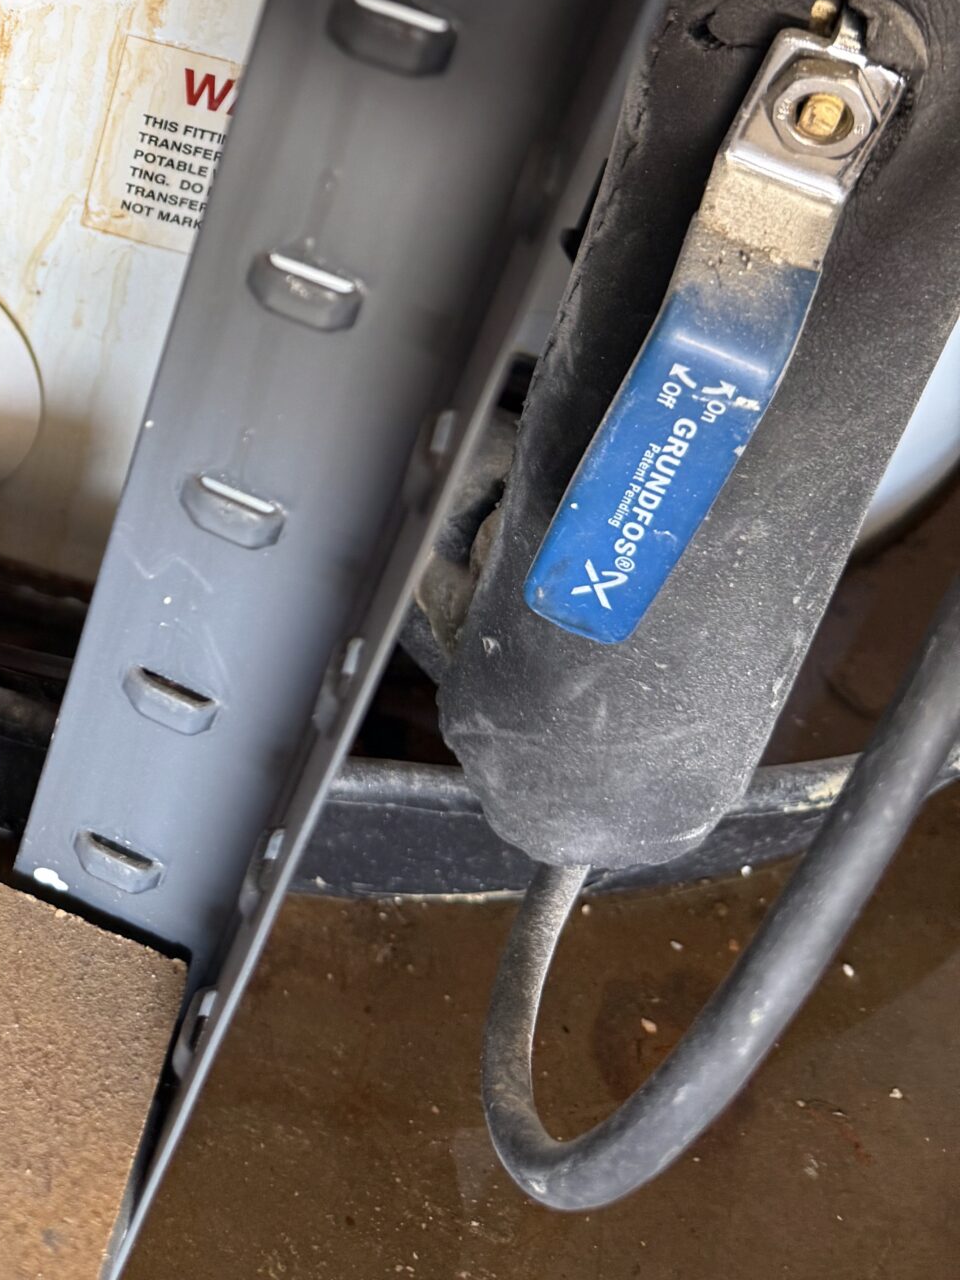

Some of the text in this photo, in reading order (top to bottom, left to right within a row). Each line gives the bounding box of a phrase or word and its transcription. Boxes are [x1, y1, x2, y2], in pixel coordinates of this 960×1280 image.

[184, 67, 239, 116] W
[143, 113, 179, 133] THIS
[133, 149, 209, 178] POTABLE
[129, 165, 170, 187] TING.
[179, 179, 204, 195] DO
[120, 199, 155, 218] NOT
[656, 381, 682, 410] Off
[700, 399, 727, 424] On
[607, 442, 662, 529] Patent Pending
